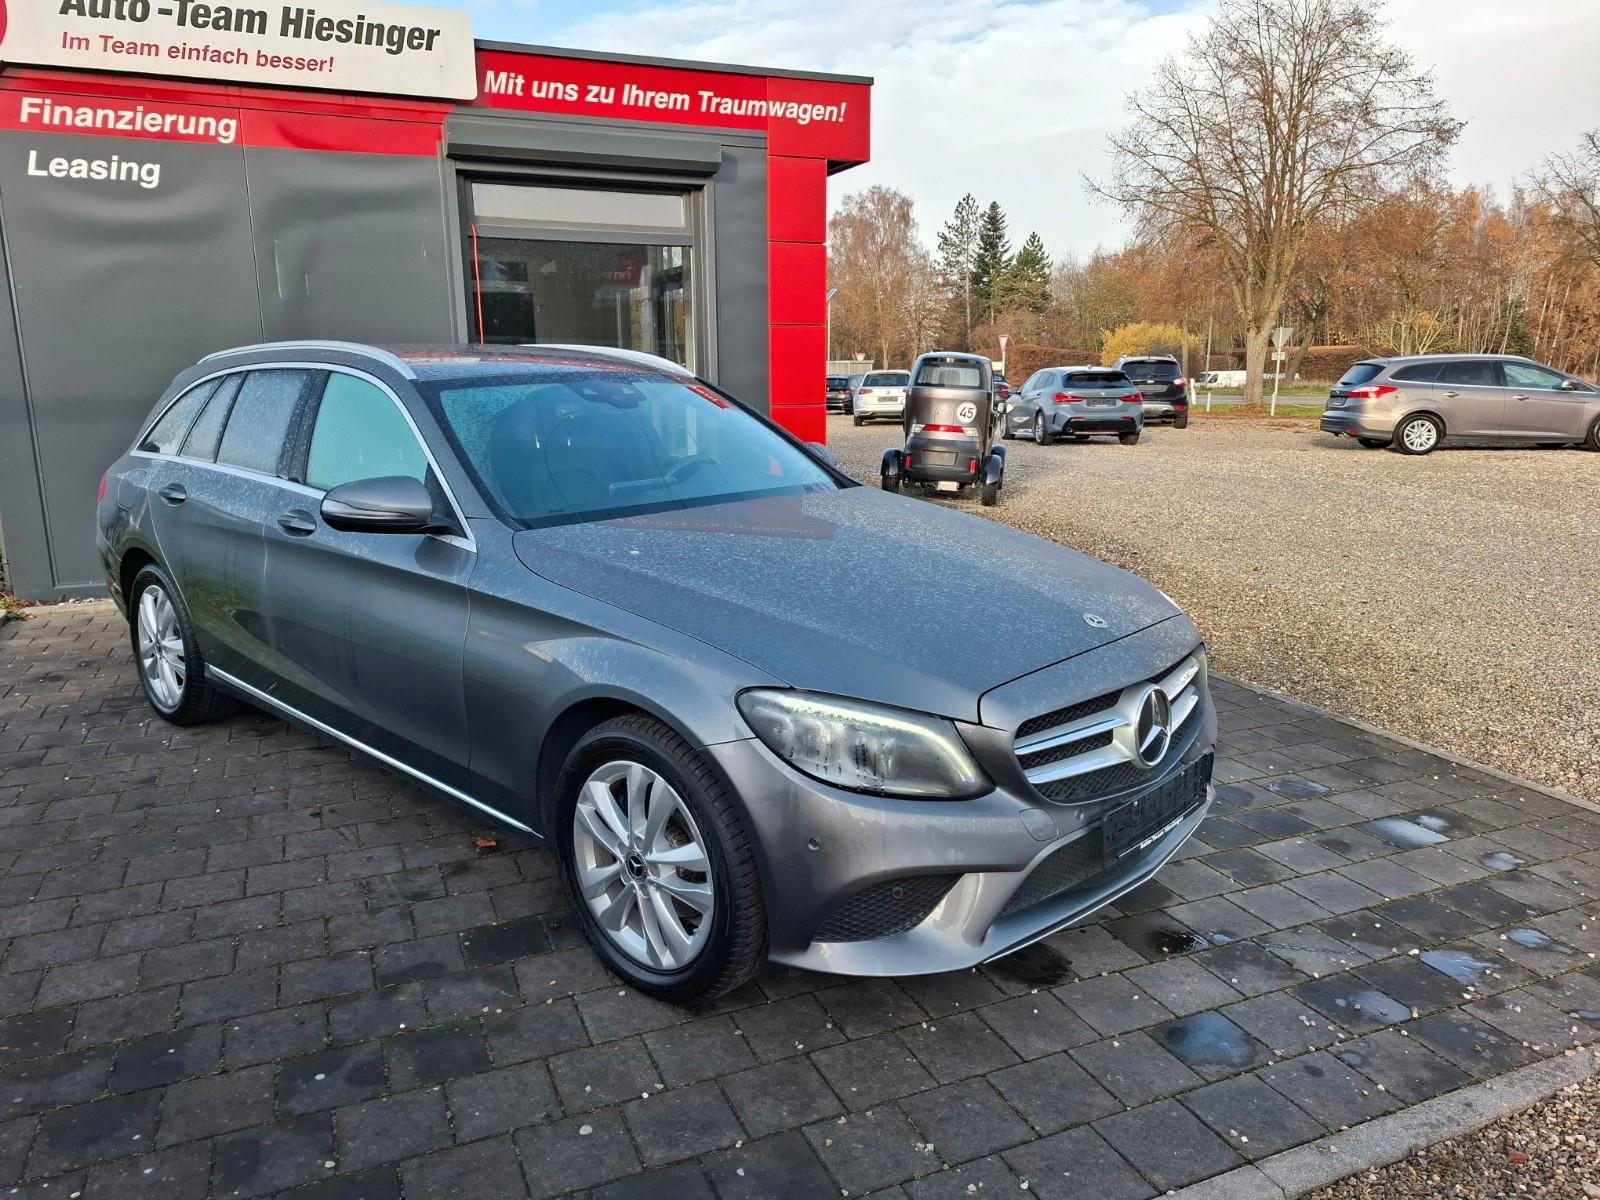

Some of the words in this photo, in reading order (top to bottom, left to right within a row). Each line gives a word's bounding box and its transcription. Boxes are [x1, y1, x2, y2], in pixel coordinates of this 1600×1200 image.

[59, 0, 150, 22] Auto
[280, 7, 441, 55] Hiesinger
[62, 31, 90, 51] Im
[99, 34, 161, 58] Team
[167, 43, 249, 65] einfach
[256, 51, 336, 74] besser!
[484, 70, 525, 96] Mit
[531, 80, 579, 101] uns
[585, 85, 615, 104] zu
[622, 83, 690, 111] Ihrem
[697, 90, 847, 125] Traumwagen!
[20, 97, 237, 143] Finanzierung
[27, 150, 161, 189] Leasing
[960, 406, 974, 419] 45
